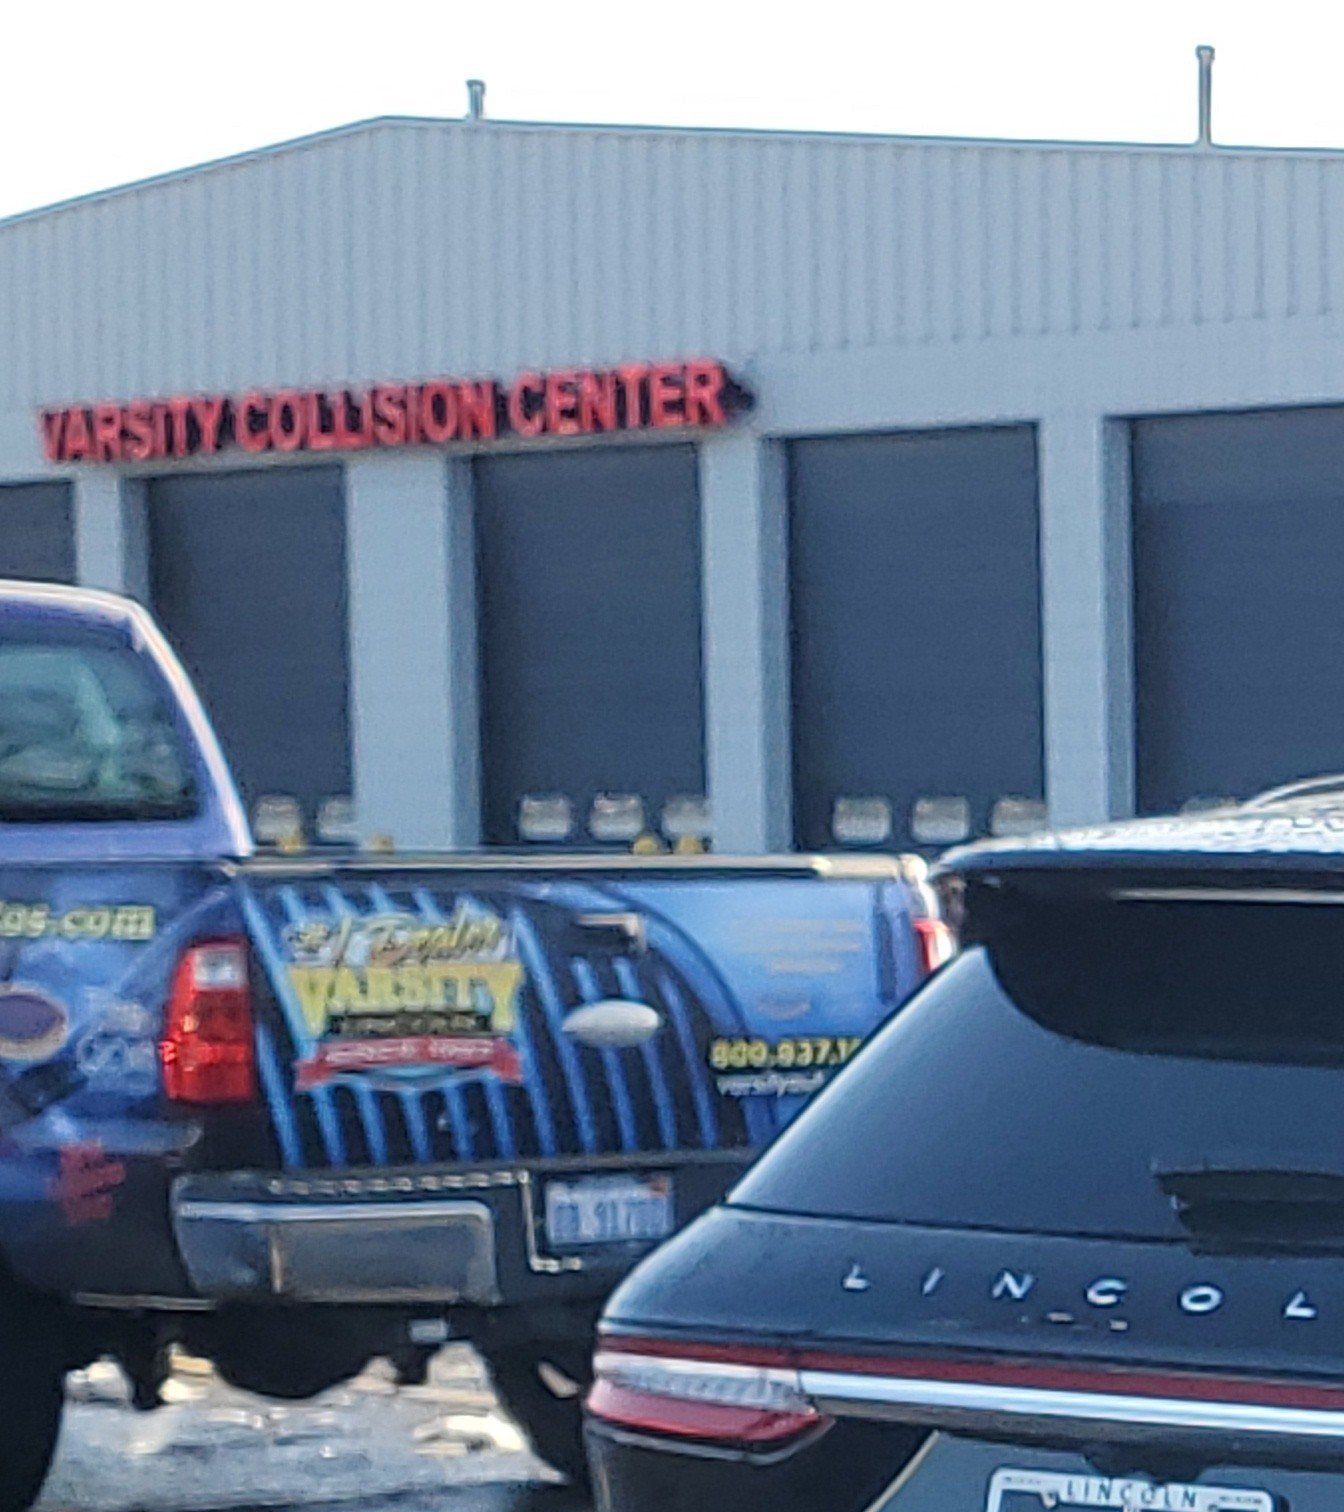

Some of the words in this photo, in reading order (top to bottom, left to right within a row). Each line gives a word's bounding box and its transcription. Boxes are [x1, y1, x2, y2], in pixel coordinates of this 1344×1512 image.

[39, 396, 228, 462] VARSITY
[233, 380, 499, 452] COLLISION
[508, 356, 727, 438] CENTER
[0, 903, 156, 940] os.com
[289, 961, 523, 1036] VARSITY
[1065, 1478, 1199, 1509] LINCOLN
